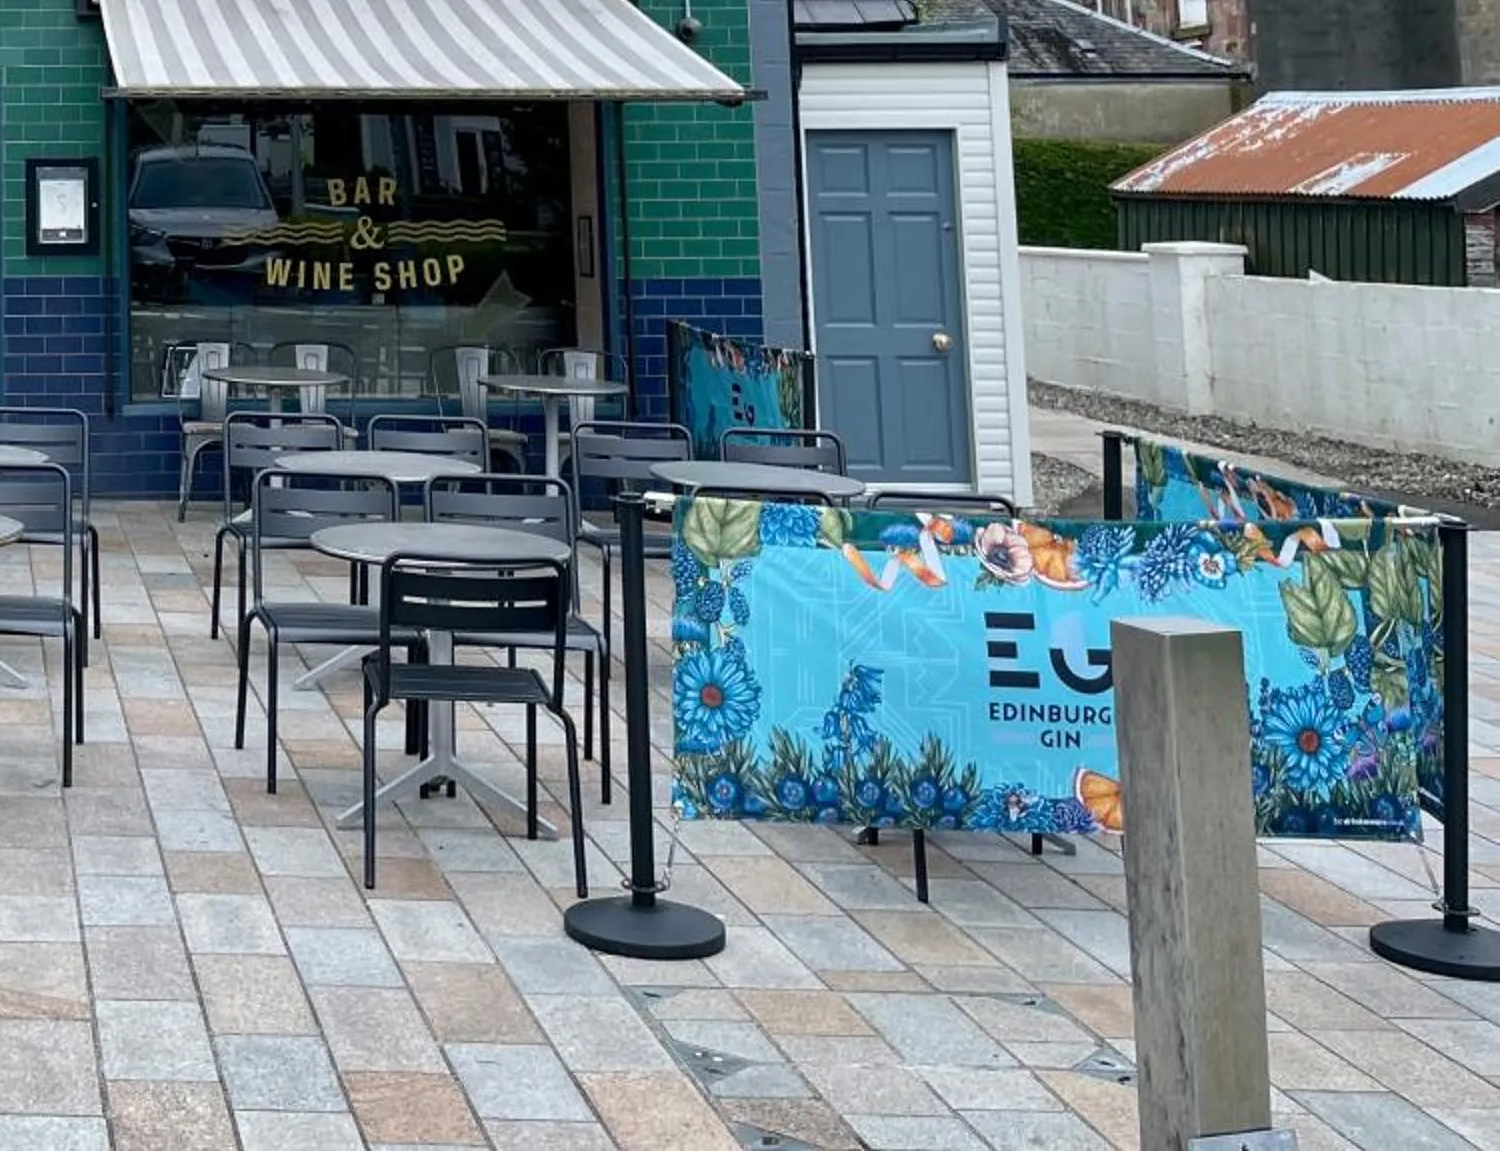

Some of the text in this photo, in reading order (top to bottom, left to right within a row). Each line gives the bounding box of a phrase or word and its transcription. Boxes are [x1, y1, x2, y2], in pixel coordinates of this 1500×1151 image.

[327, 176, 398, 207] BAR
[351, 215, 385, 250] &
[266, 254, 466, 291] WINE SHOP
[984, 612, 1114, 694] EG
[988, 702, 1112, 726] EDINBURG
[1040, 729, 1081, 749] GIN
